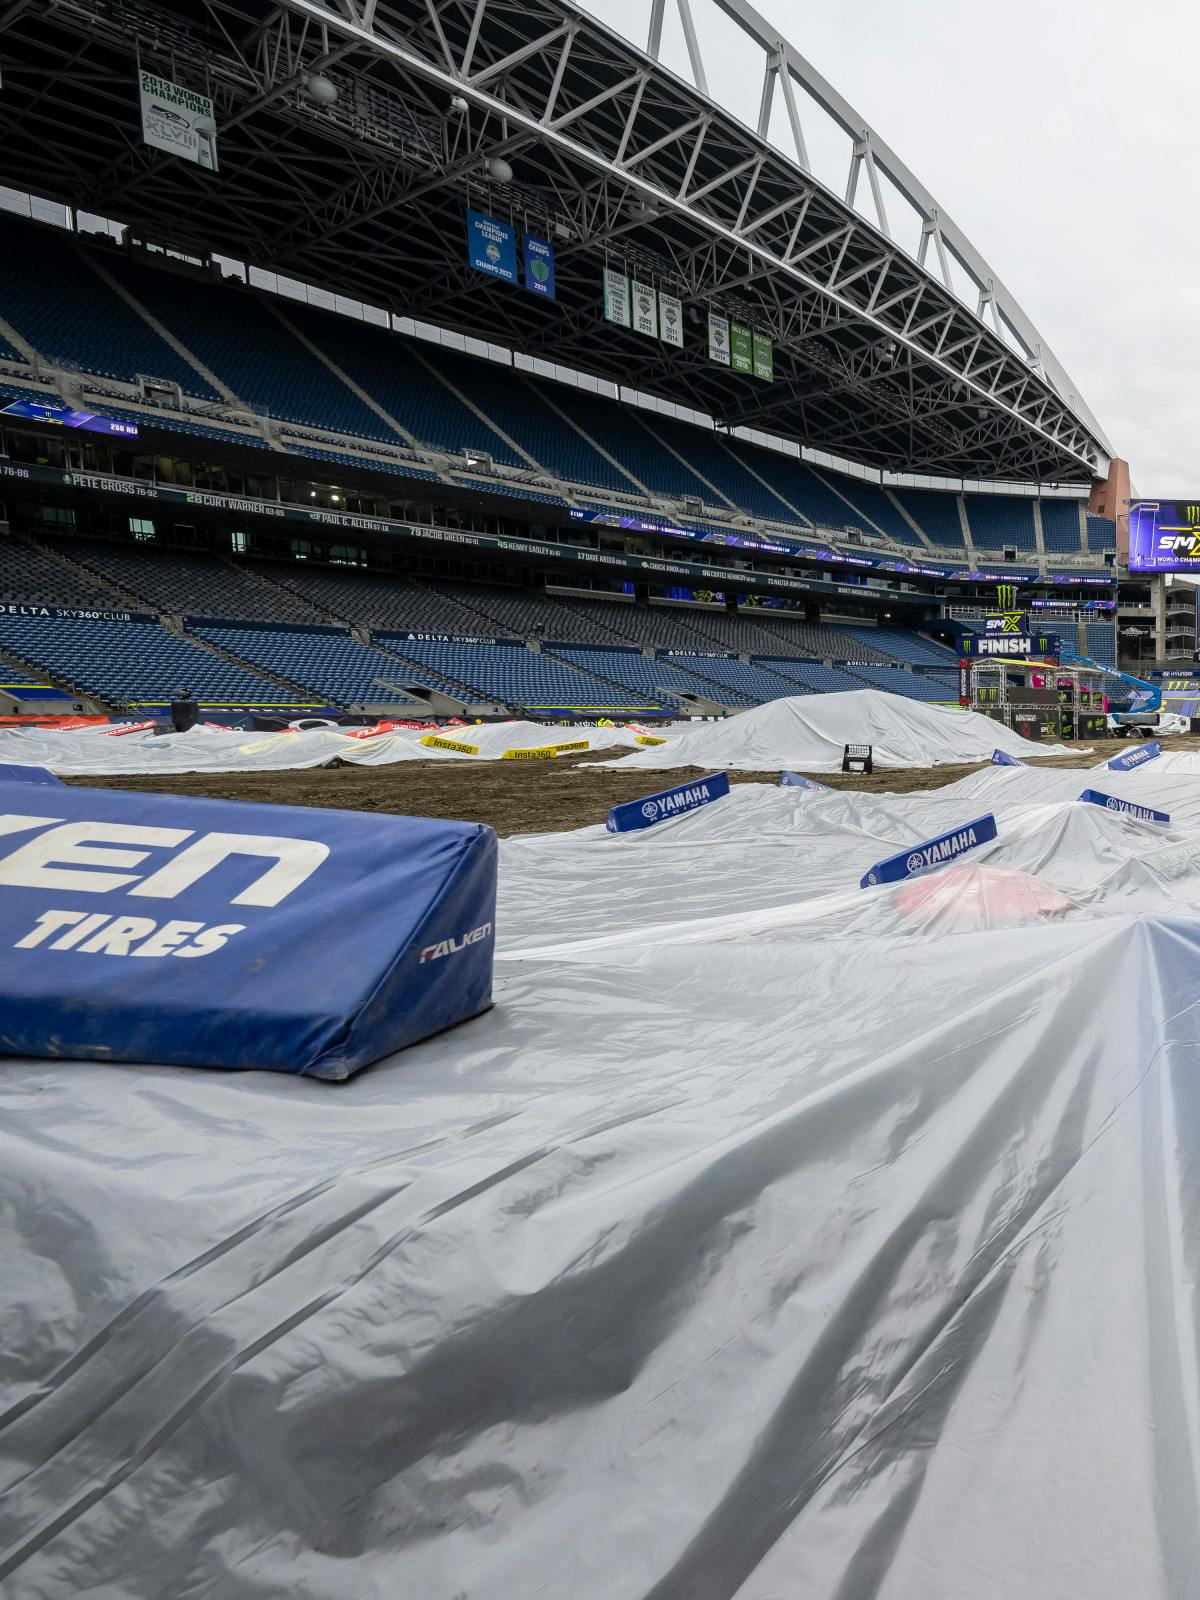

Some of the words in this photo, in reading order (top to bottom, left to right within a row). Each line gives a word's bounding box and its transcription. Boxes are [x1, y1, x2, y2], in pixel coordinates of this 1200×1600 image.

[141, 73, 171, 92] 2013
[173, 85, 211, 109] WORLD
[142, 82, 211, 118] CHAMPIONS
[474, 221, 508, 240] CHAMPIONS
[481, 230, 503, 244] LEAGUE
[528, 243, 550, 257] CHAMPS
[475, 259, 499, 273] CHAMPS
[499, 268, 513, 279] 2022
[666, 326, 678, 335] 2011
[2, 466, 30, 478] 76-86
[72, 475, 99, 489] PETE
[100, 480, 135, 494] GROSS
[136, 487, 158, 498] 76-92
[186, 493, 202, 504] 28
[203, 495, 227, 508] CURT
[228, 499, 265, 514] WARNER
[322, 513, 341, 526] PAUL
[351, 518, 373, 530] ALLEN
[410, 527, 422, 537] 79
[422, 528, 442, 540] JACOB
[443, 531, 465, 543] GREEN
[508, 541, 528, 552] KENNY
[528, 545, 550, 555] EASLEY
[577, 552, 585, 560] 17
[585, 553, 599, 562] DAVE
[599, 555, 616, 564] KRIEG
[649, 562, 666, 572] CHUCK
[666, 564, 680, 574] KNOX
[702, 569, 711, 577] 96
[0, 605, 50, 616] DELTA
[985, 615, 1021, 632] SMX
[417, 633, 449, 642] DELTA
[978, 638, 1031, 654] FINISH
[356, 726, 382, 738] FLY
[433, 738, 473, 754] Insta360
[514, 750, 551, 759] Insta360
[1127, 749, 1150, 765] YAMAHA
[656, 784, 711, 813] YAMAHA
[1118, 801, 1155, 821] YAMAHA
[922, 827, 977, 865] YAMAHA
[13, 909, 248, 959] TIRES
[419, 922, 492, 965] FALKEN
